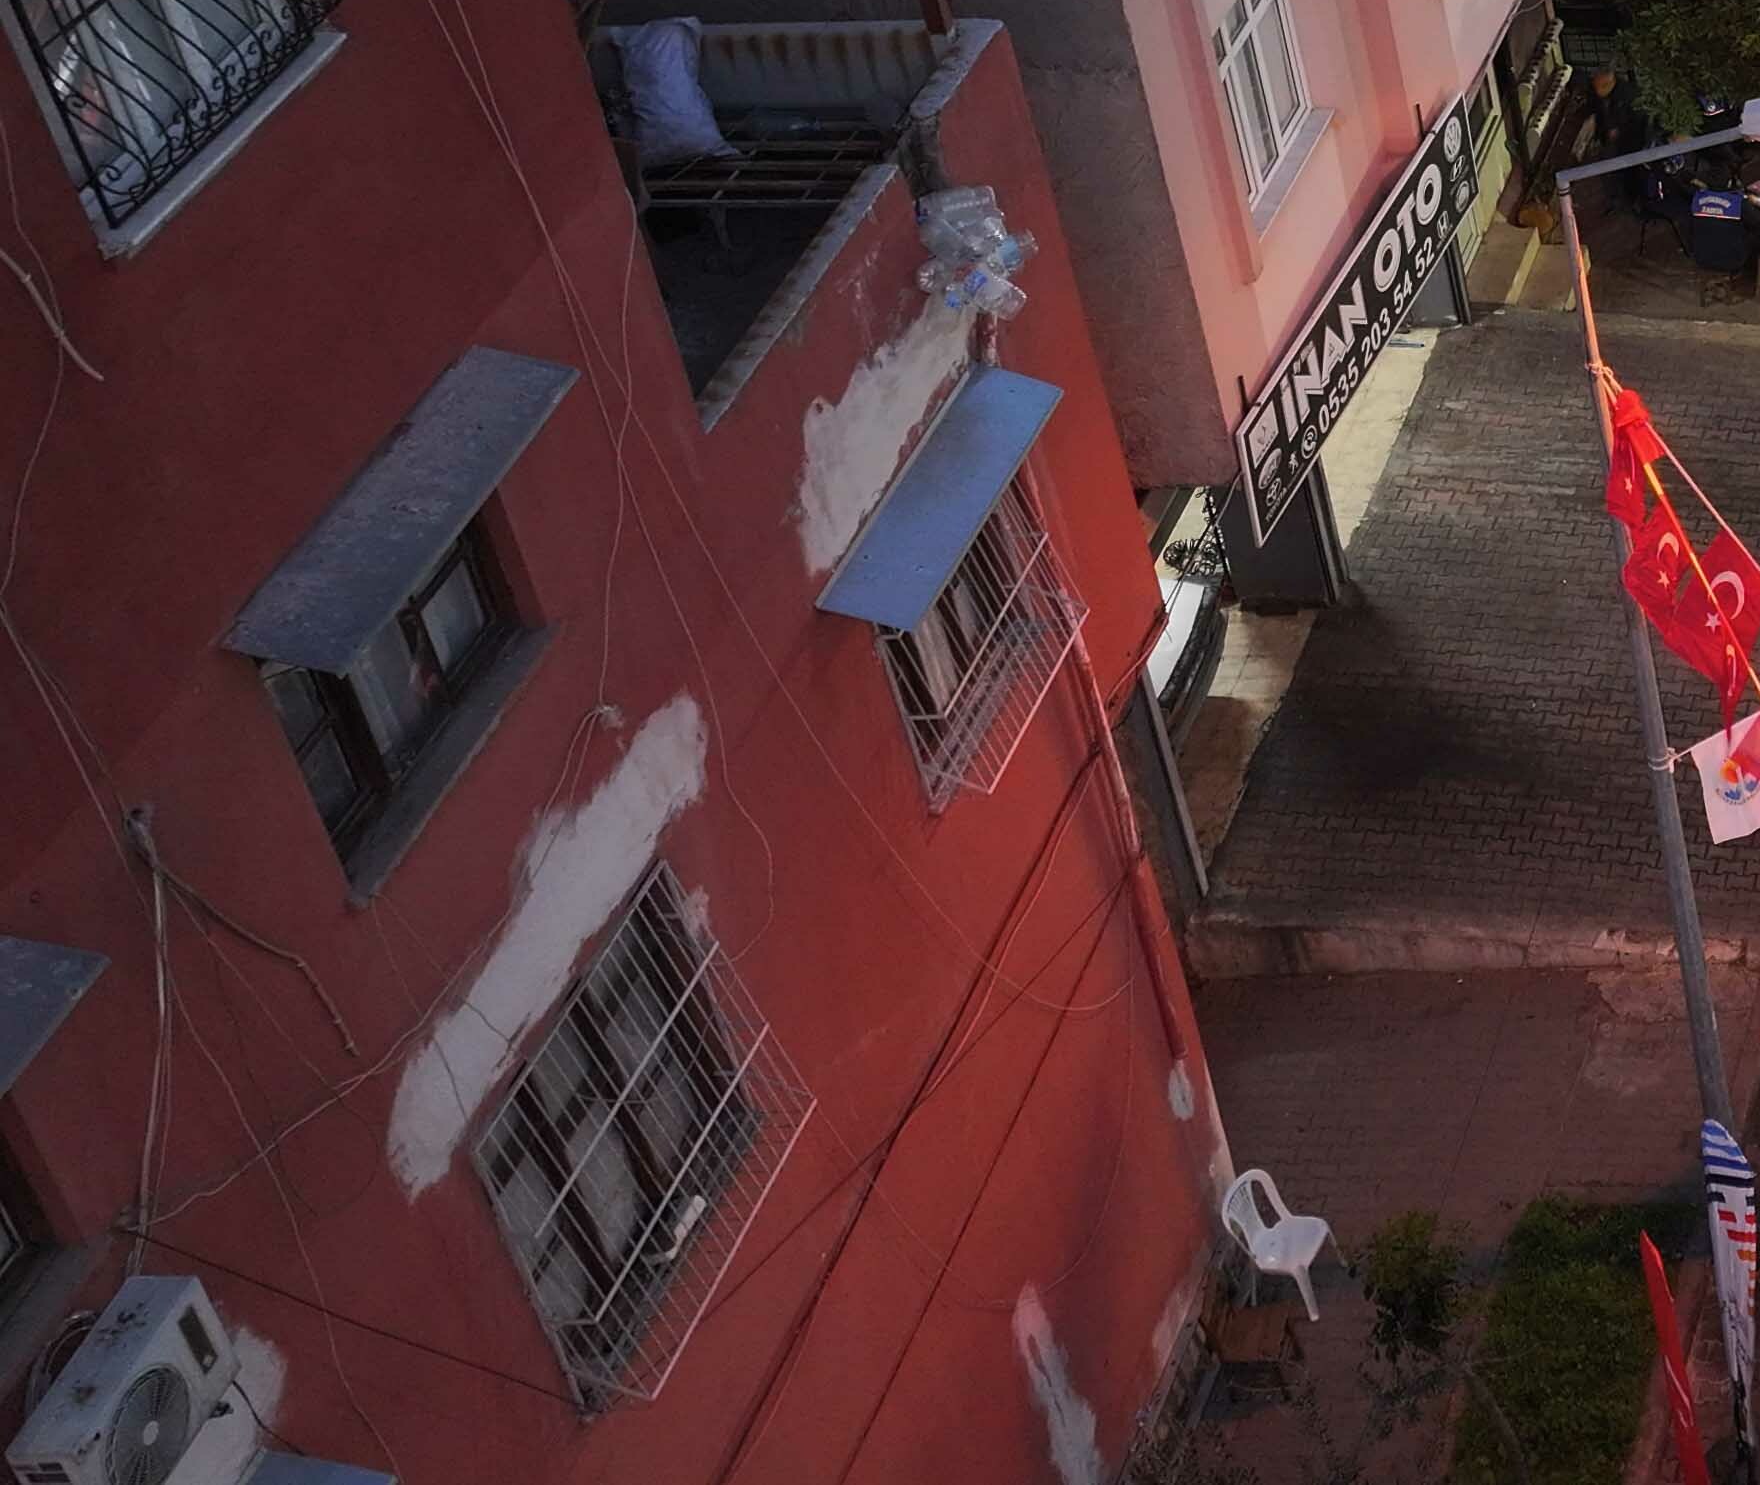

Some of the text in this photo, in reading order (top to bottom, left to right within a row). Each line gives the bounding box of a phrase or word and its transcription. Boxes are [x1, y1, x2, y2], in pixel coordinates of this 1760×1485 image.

[1373, 163, 1442, 292] OTO
[1318, 236, 1435, 433] 0535 203 54 52
